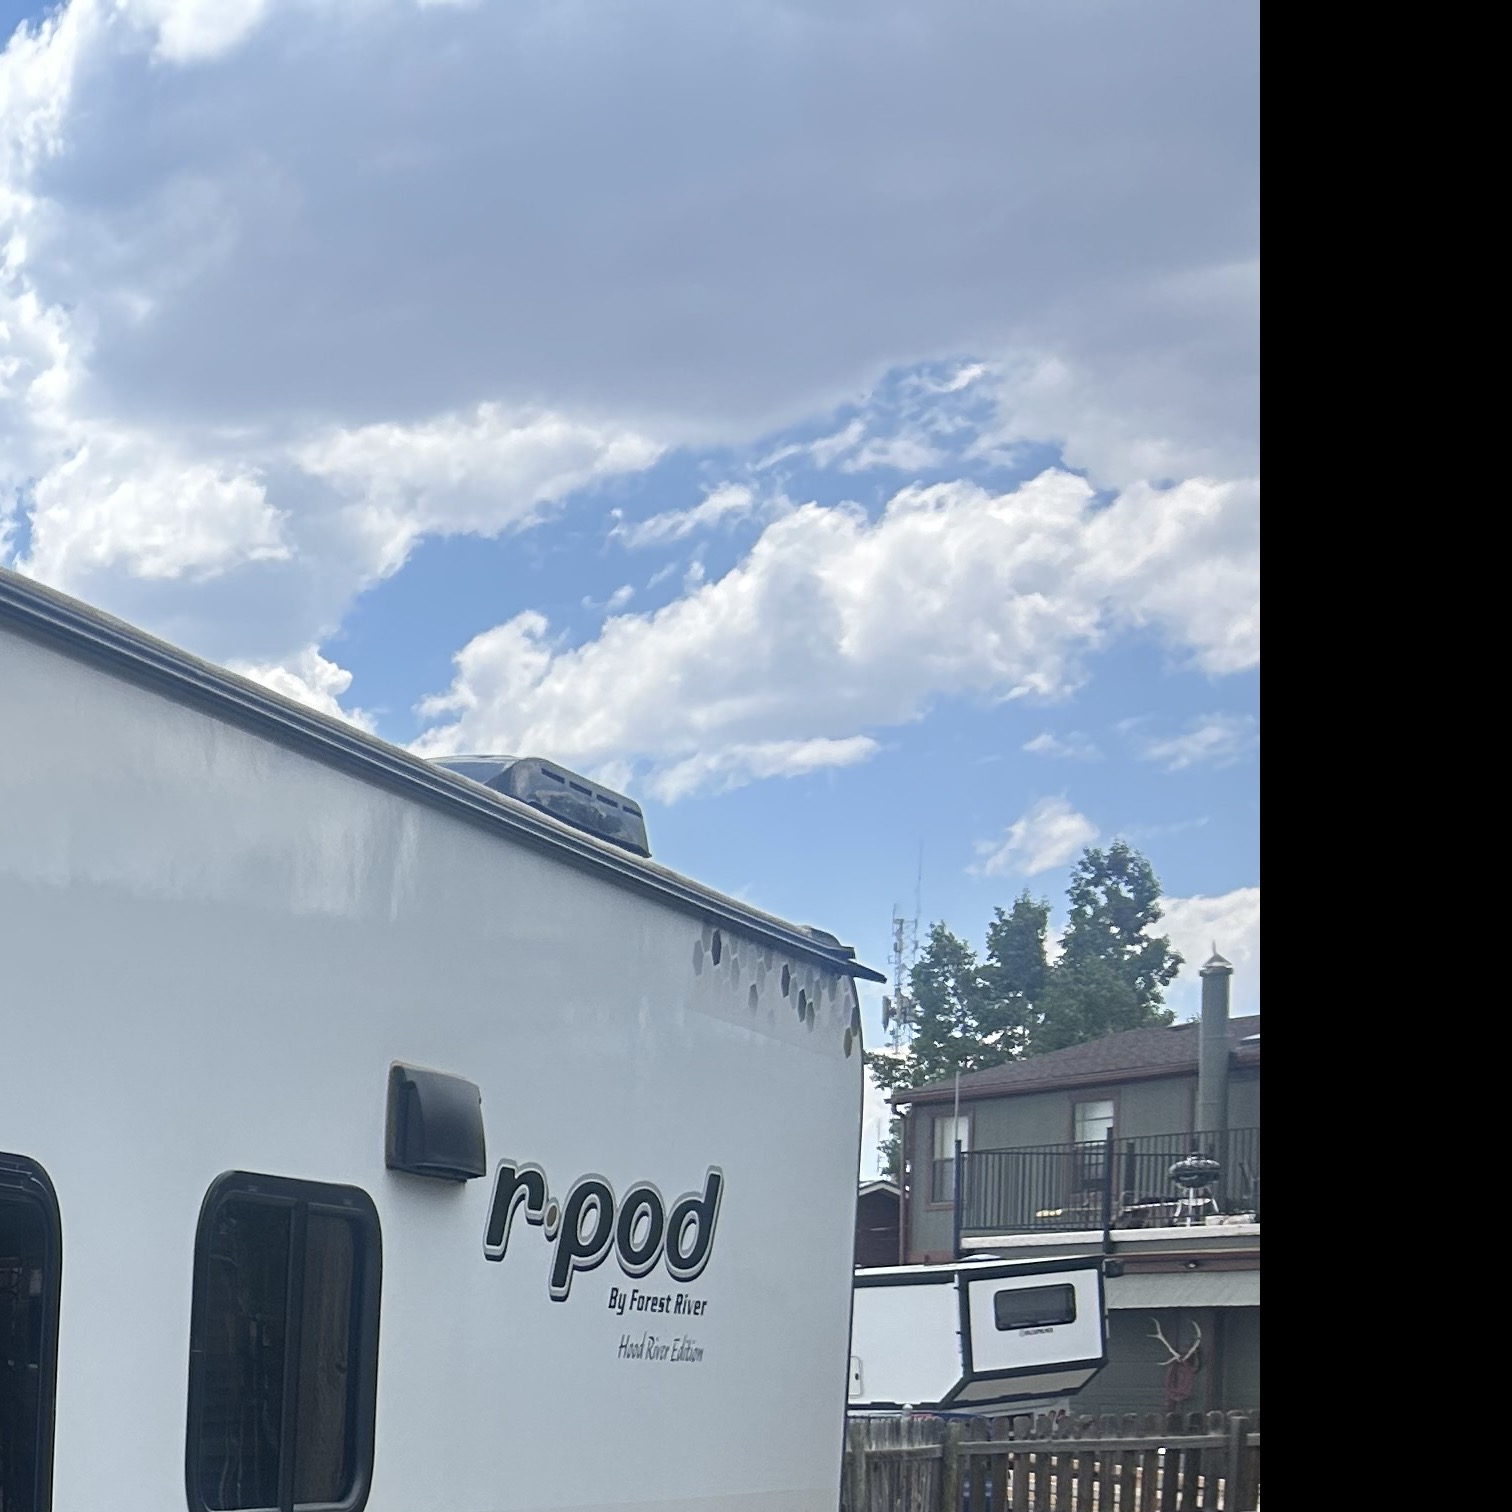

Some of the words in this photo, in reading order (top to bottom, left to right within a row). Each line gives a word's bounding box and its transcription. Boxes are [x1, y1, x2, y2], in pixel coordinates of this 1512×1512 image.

[608, 1287, 626, 1315] By
[629, 1290, 671, 1314] Forest
[674, 1294, 708, 1316] River
[617, 1331, 646, 1360] Hood
[646, 1336, 670, 1360] River
[670, 1335, 704, 1362] Edition
